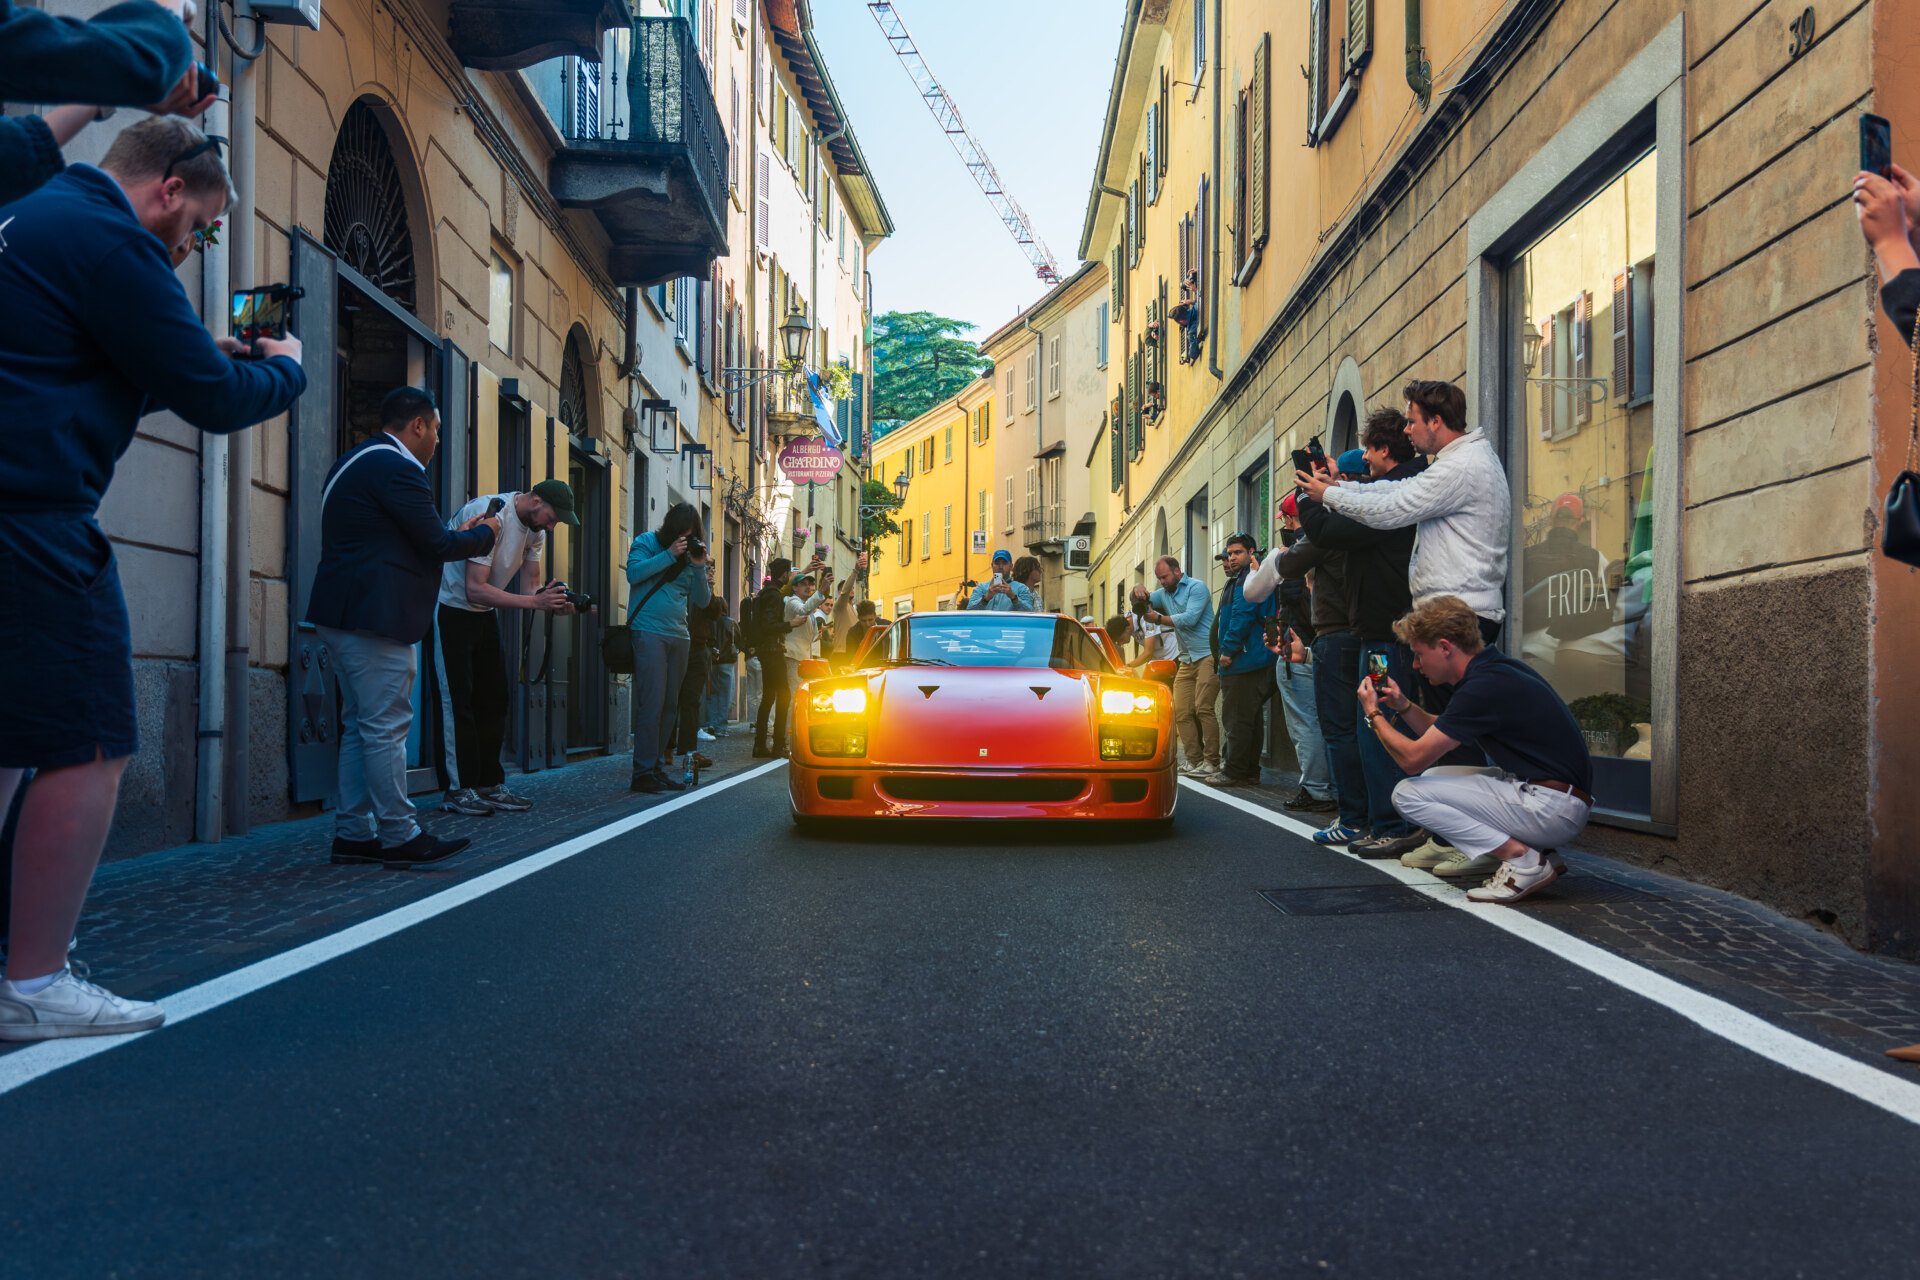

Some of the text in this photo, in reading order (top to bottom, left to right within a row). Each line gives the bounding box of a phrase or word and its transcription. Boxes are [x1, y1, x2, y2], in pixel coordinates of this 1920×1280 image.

[1789, 6, 1815, 57] 30
[782, 456, 840, 468] GIARDINO
[792, 445, 821, 454] ALBERGO
[1548, 567, 1610, 618] FRIDA
